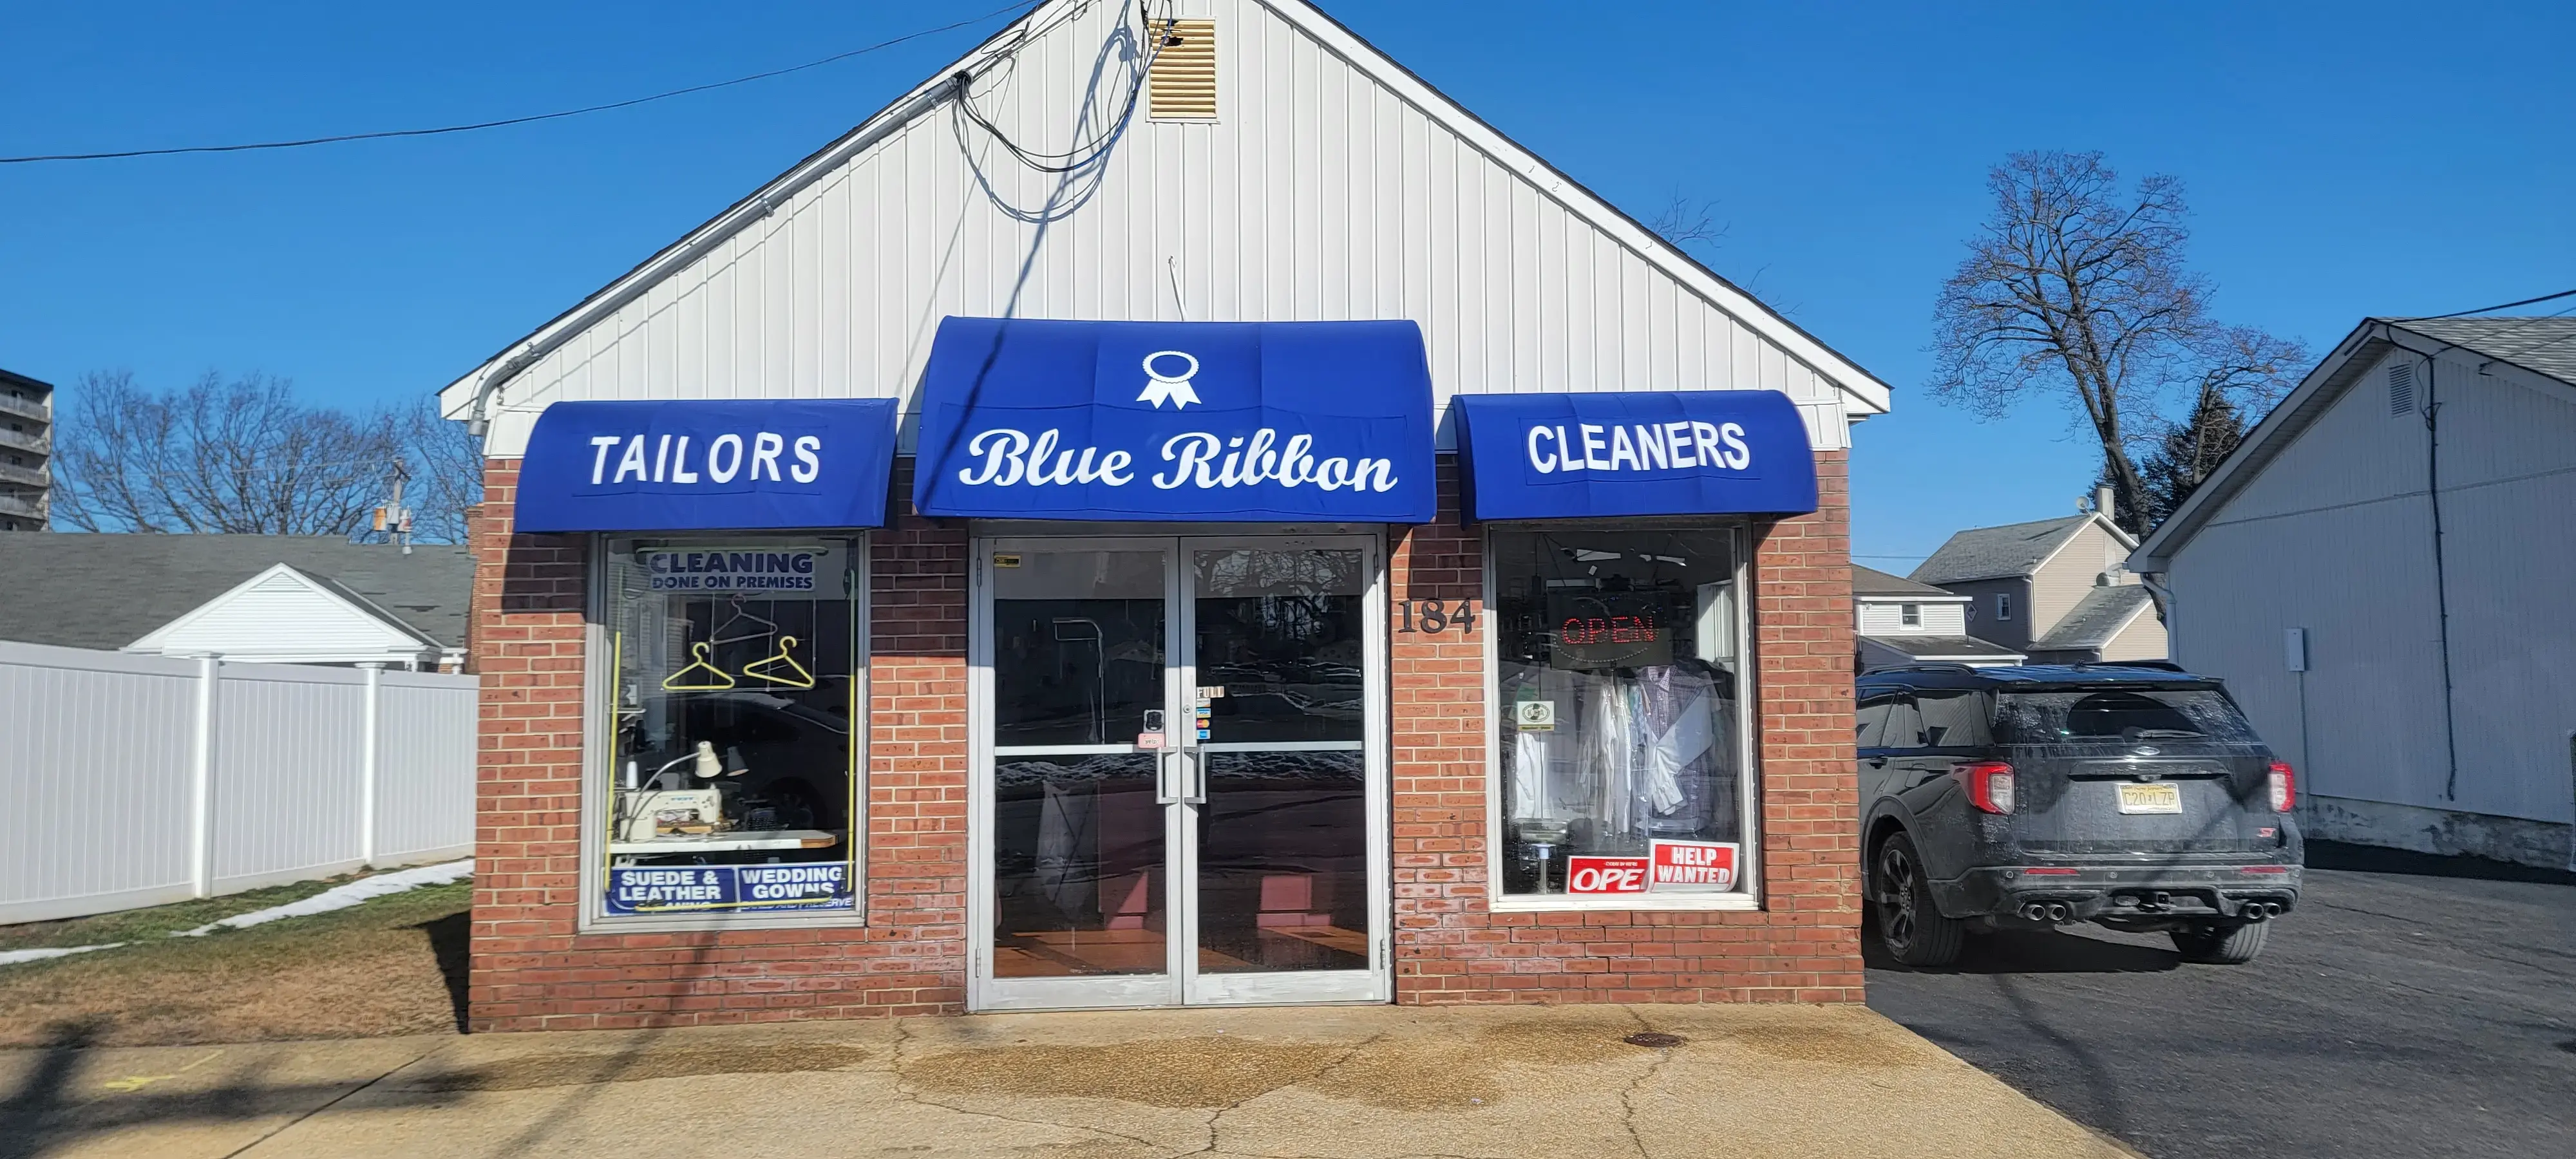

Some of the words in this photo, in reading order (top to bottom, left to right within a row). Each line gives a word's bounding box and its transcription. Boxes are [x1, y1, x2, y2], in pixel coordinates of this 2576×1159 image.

[1528, 421, 1750, 473] CLEANERS
[591, 432, 821, 484] TAILORS
[958, 428, 1134, 487] Blue
[1151, 428, 1398, 493] Ribbon
[650, 553, 813, 574] CLEANING
[652, 576, 699, 589] DONE
[705, 576, 731, 589] ON
[737, 576, 813, 589] PREMISES
[1398, 598, 1476, 634] 184
[1562, 616, 1658, 645] OPEN
[1671, 847, 1717, 866] HELP
[621, 871, 696, 887] SUEDE
[703, 871, 719, 885] &
[741, 867, 842, 884] WEDDING
[1573, 868, 1649, 891] OPE
[1657, 865, 1730, 883] WANTED
[619, 886, 722, 901] LEATHER
